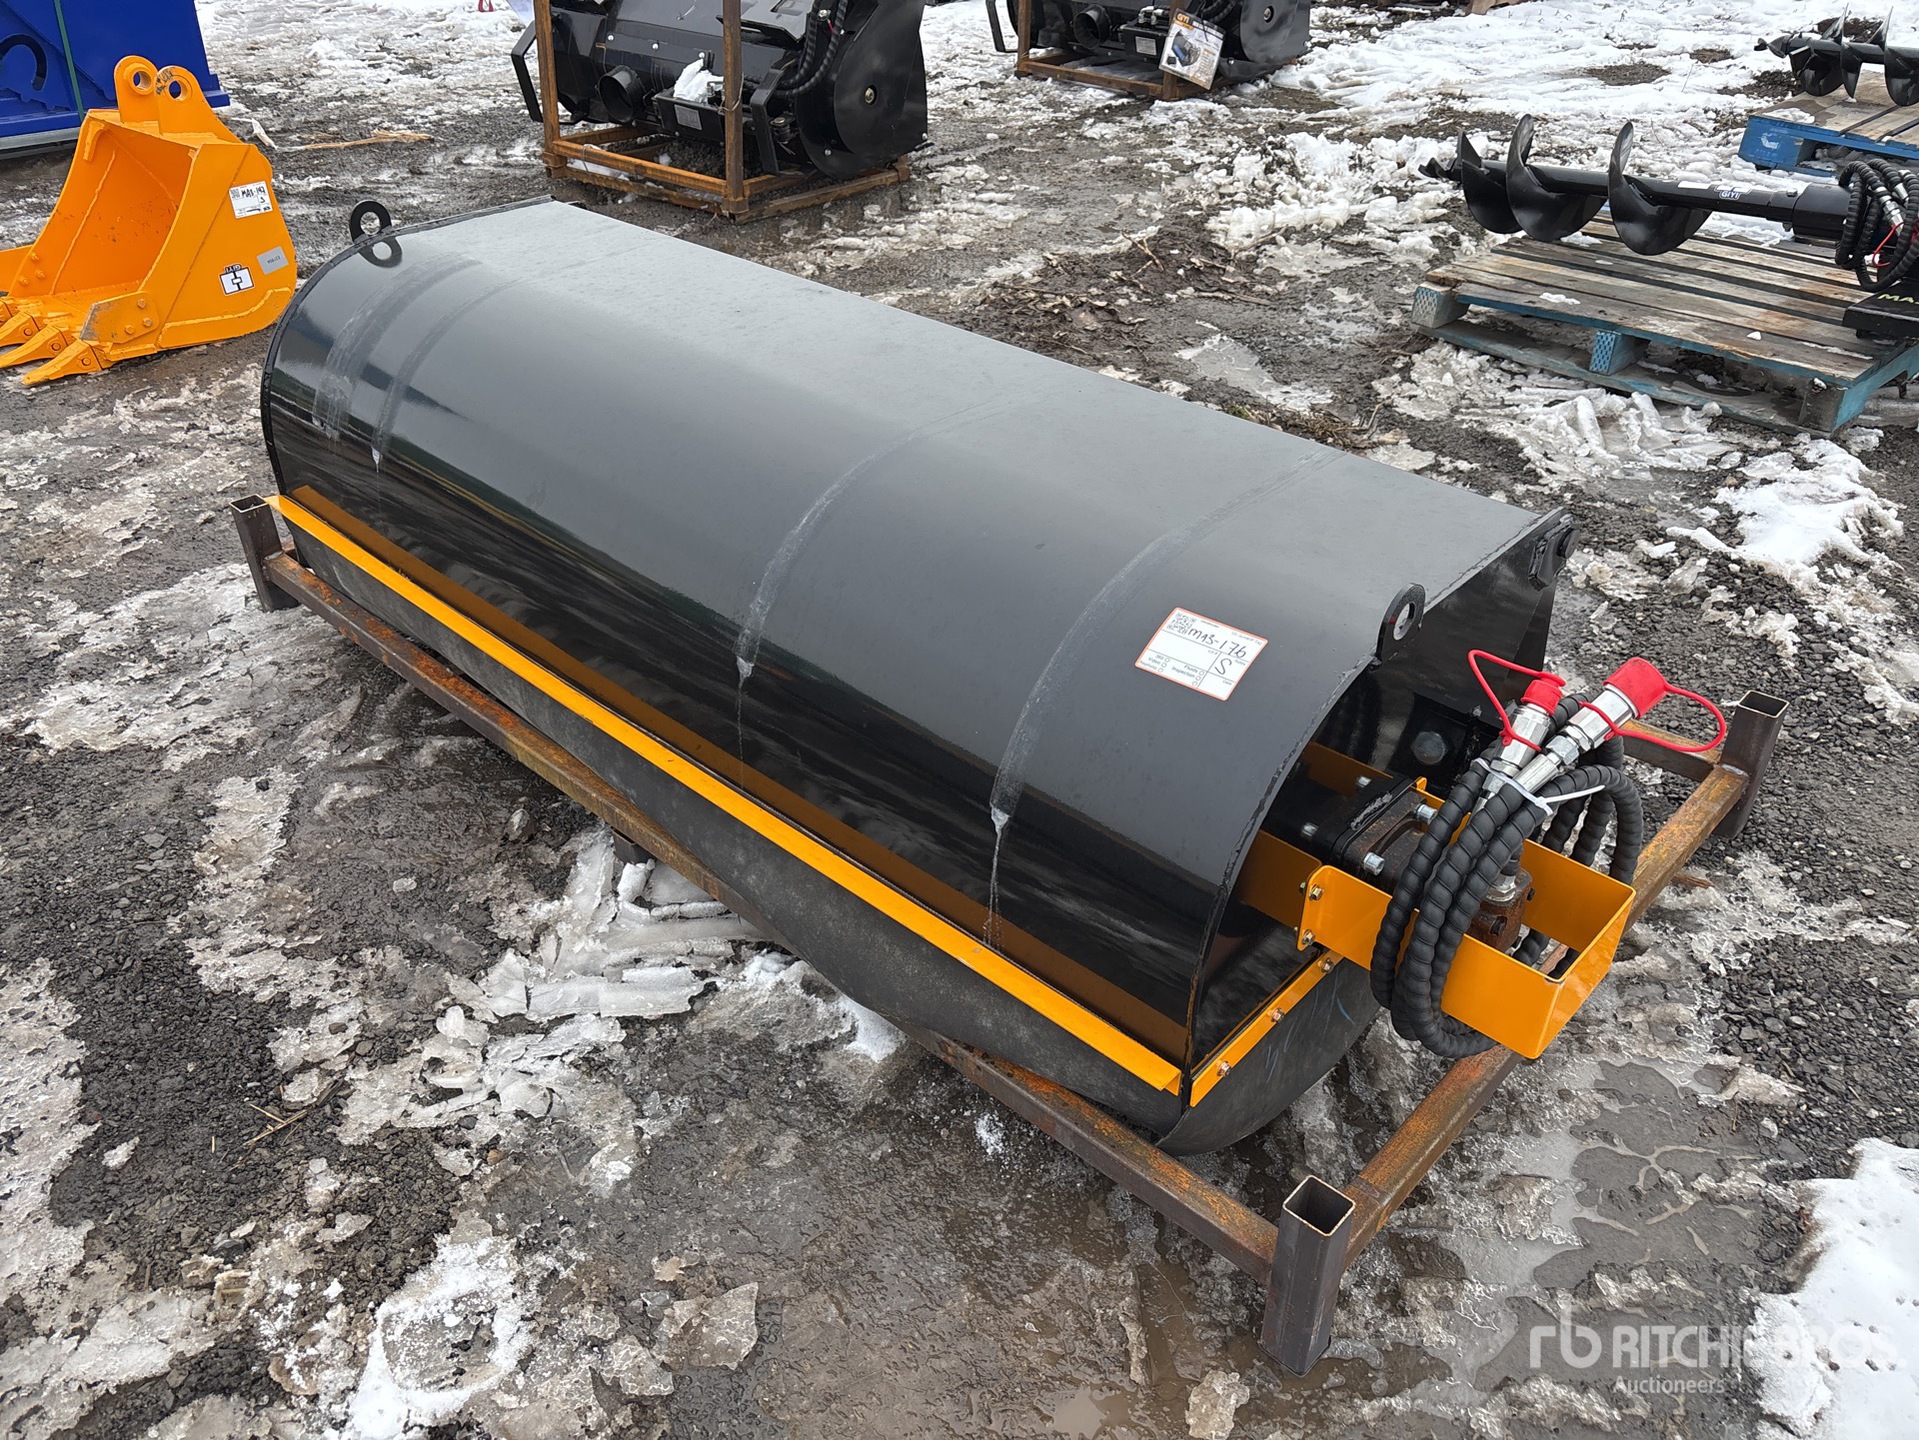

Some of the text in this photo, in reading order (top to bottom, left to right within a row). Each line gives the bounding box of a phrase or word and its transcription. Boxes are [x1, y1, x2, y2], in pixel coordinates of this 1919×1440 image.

[1721, 190, 1739, 199] GIYI
[1877, 293, 1919, 305] MA
[1214, 657, 1232, 675] S
